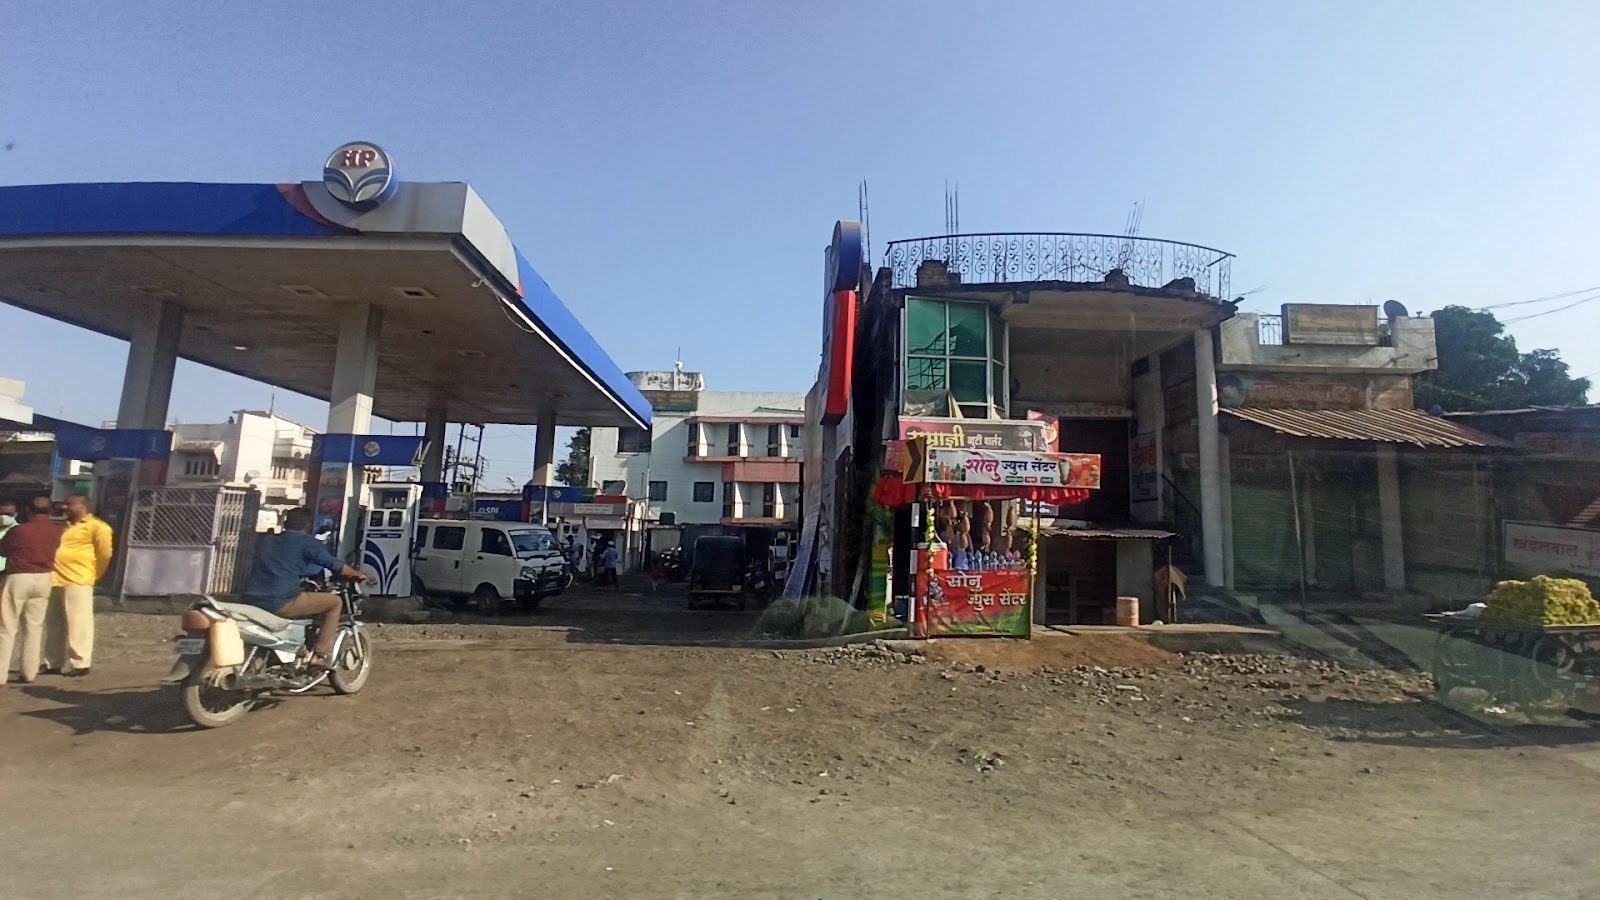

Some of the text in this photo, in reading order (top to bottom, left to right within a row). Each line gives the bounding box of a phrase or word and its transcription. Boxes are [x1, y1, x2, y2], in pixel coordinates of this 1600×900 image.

[341, 149, 378, 167] HP
[1031, 457, 1057, 473] सेंटर
[999, 587, 1027, 606] सेंटर
